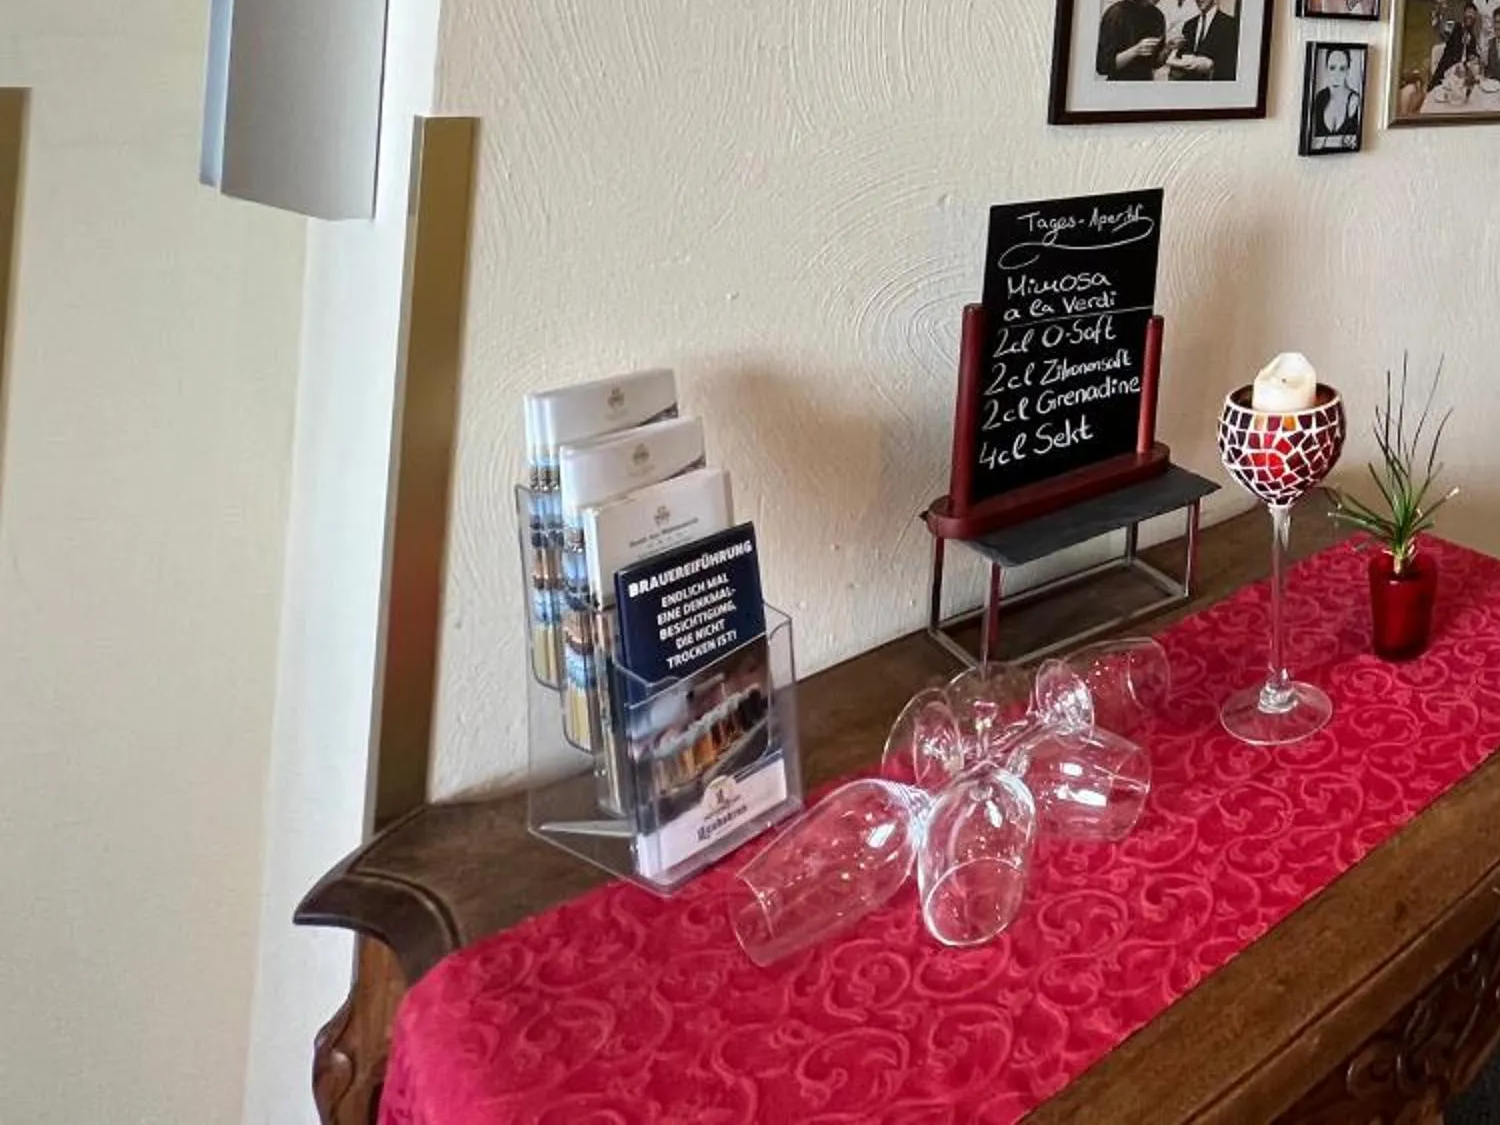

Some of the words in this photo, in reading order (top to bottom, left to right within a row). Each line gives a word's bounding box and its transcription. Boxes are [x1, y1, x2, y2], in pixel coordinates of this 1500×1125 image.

[1007, 272, 1112, 299] Mimosa
[1029, 298, 1055, 317] la
[1062, 290, 1117, 314] Verdi
[1041, 313, 1117, 347] O-Saft
[1036, 375, 1140, 414] Grenadine
[1033, 413, 1094, 455] Sekt
[628, 540, 753, 598] BRAUEREIFÜHRUNG
[657, 607, 681, 626] EINE
[683, 586, 737, 616] DENKMAL-
[661, 581, 705, 608] ENDLICH
[706, 572, 730, 590] MAL
[659, 600, 737, 641] BESICHTIGUNG,
[675, 632, 694, 650] DIE
[695, 618, 726, 642] NICHT
[666, 639, 717, 670] TROCKEN
